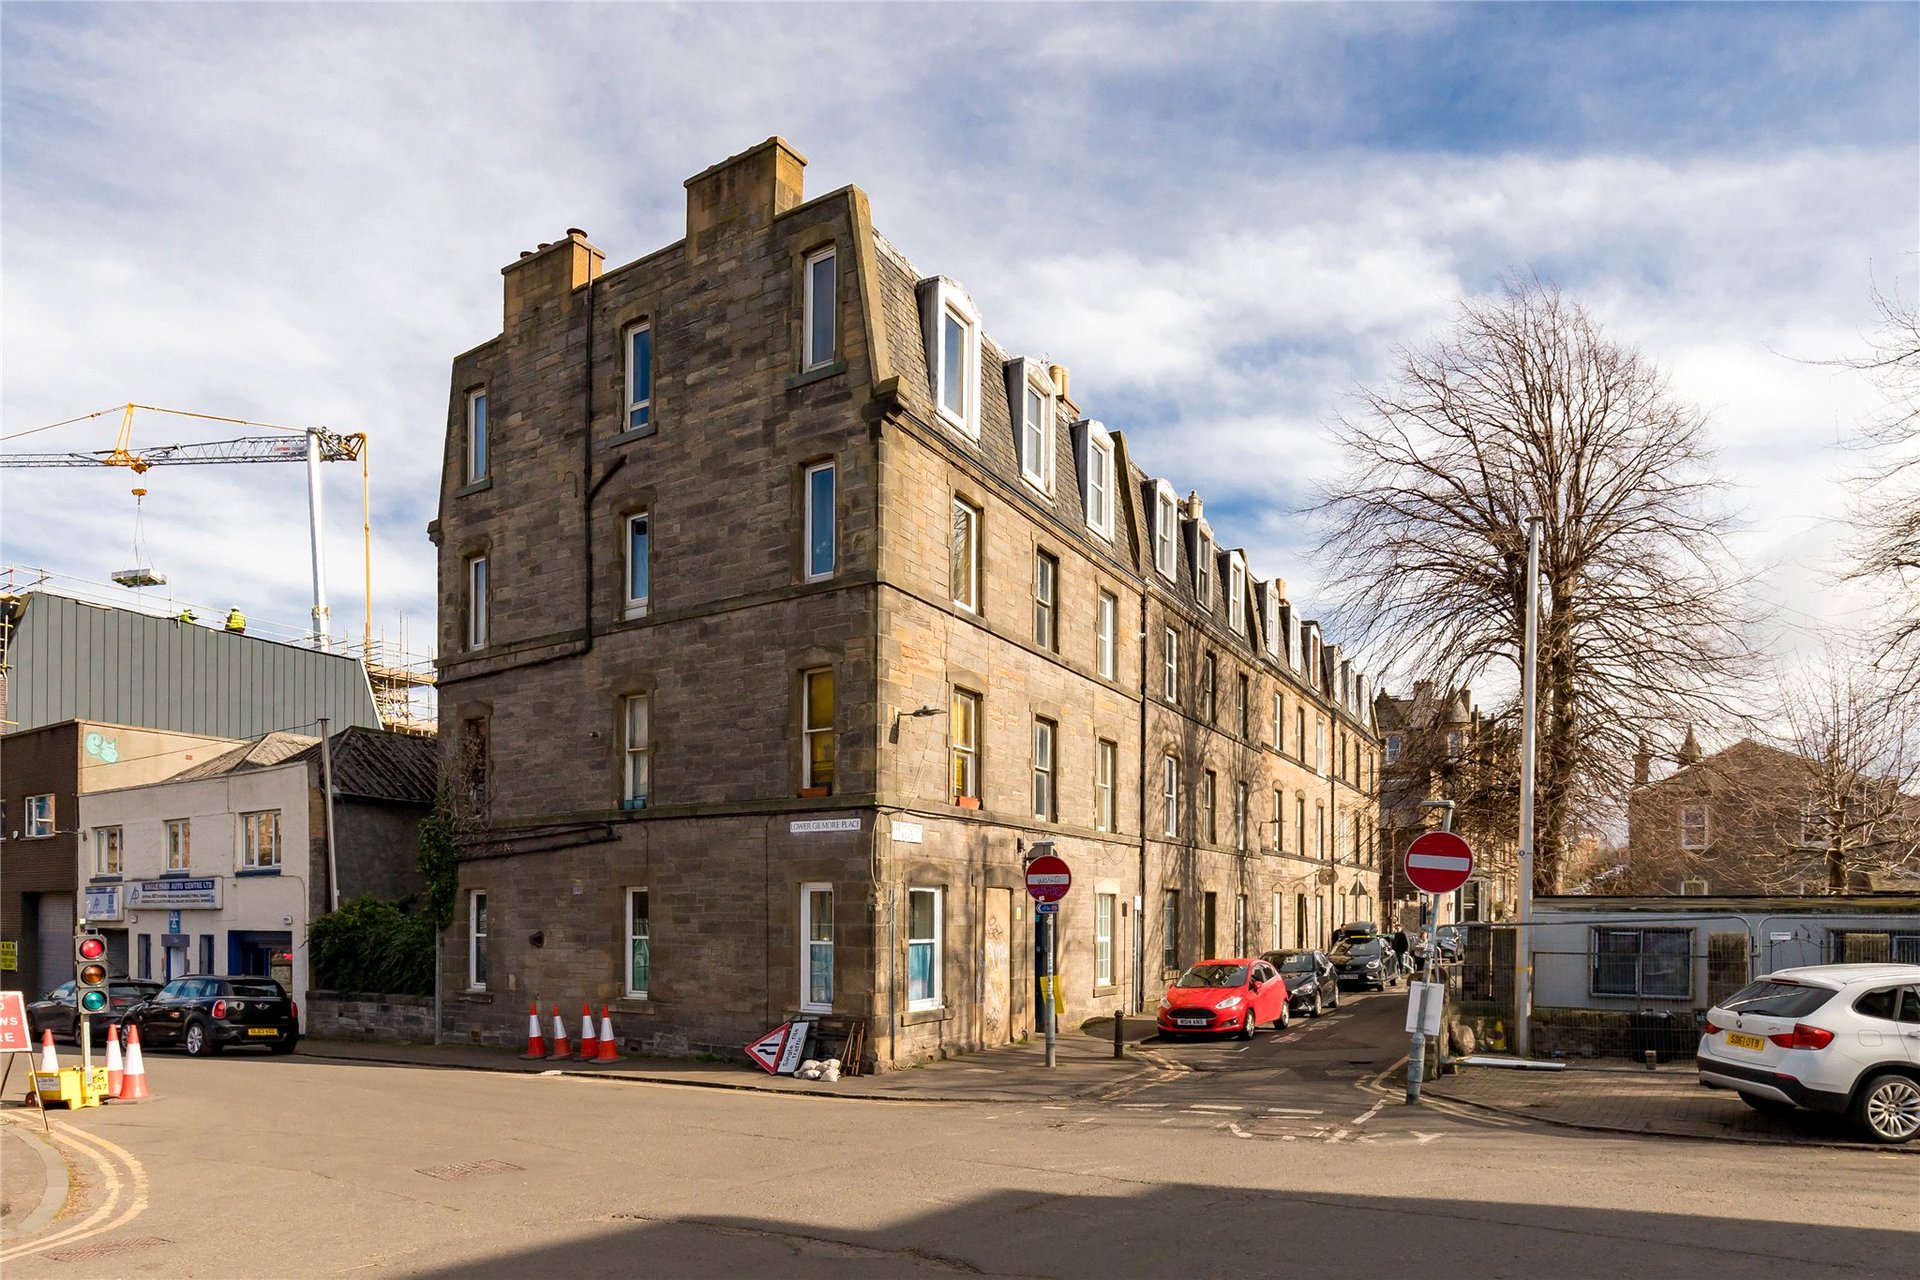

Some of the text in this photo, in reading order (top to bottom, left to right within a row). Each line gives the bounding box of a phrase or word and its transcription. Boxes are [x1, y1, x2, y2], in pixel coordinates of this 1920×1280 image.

[791, 819, 860, 831] LOWER GILMORE PLACE
[171, 882, 184, 890] AUTO
[184, 881, 203, 889] CENTRE
[203, 881, 213, 889] LTD
[782, 1028, 800, 1067] Single file
[792, 1036, 803, 1059] traffic
